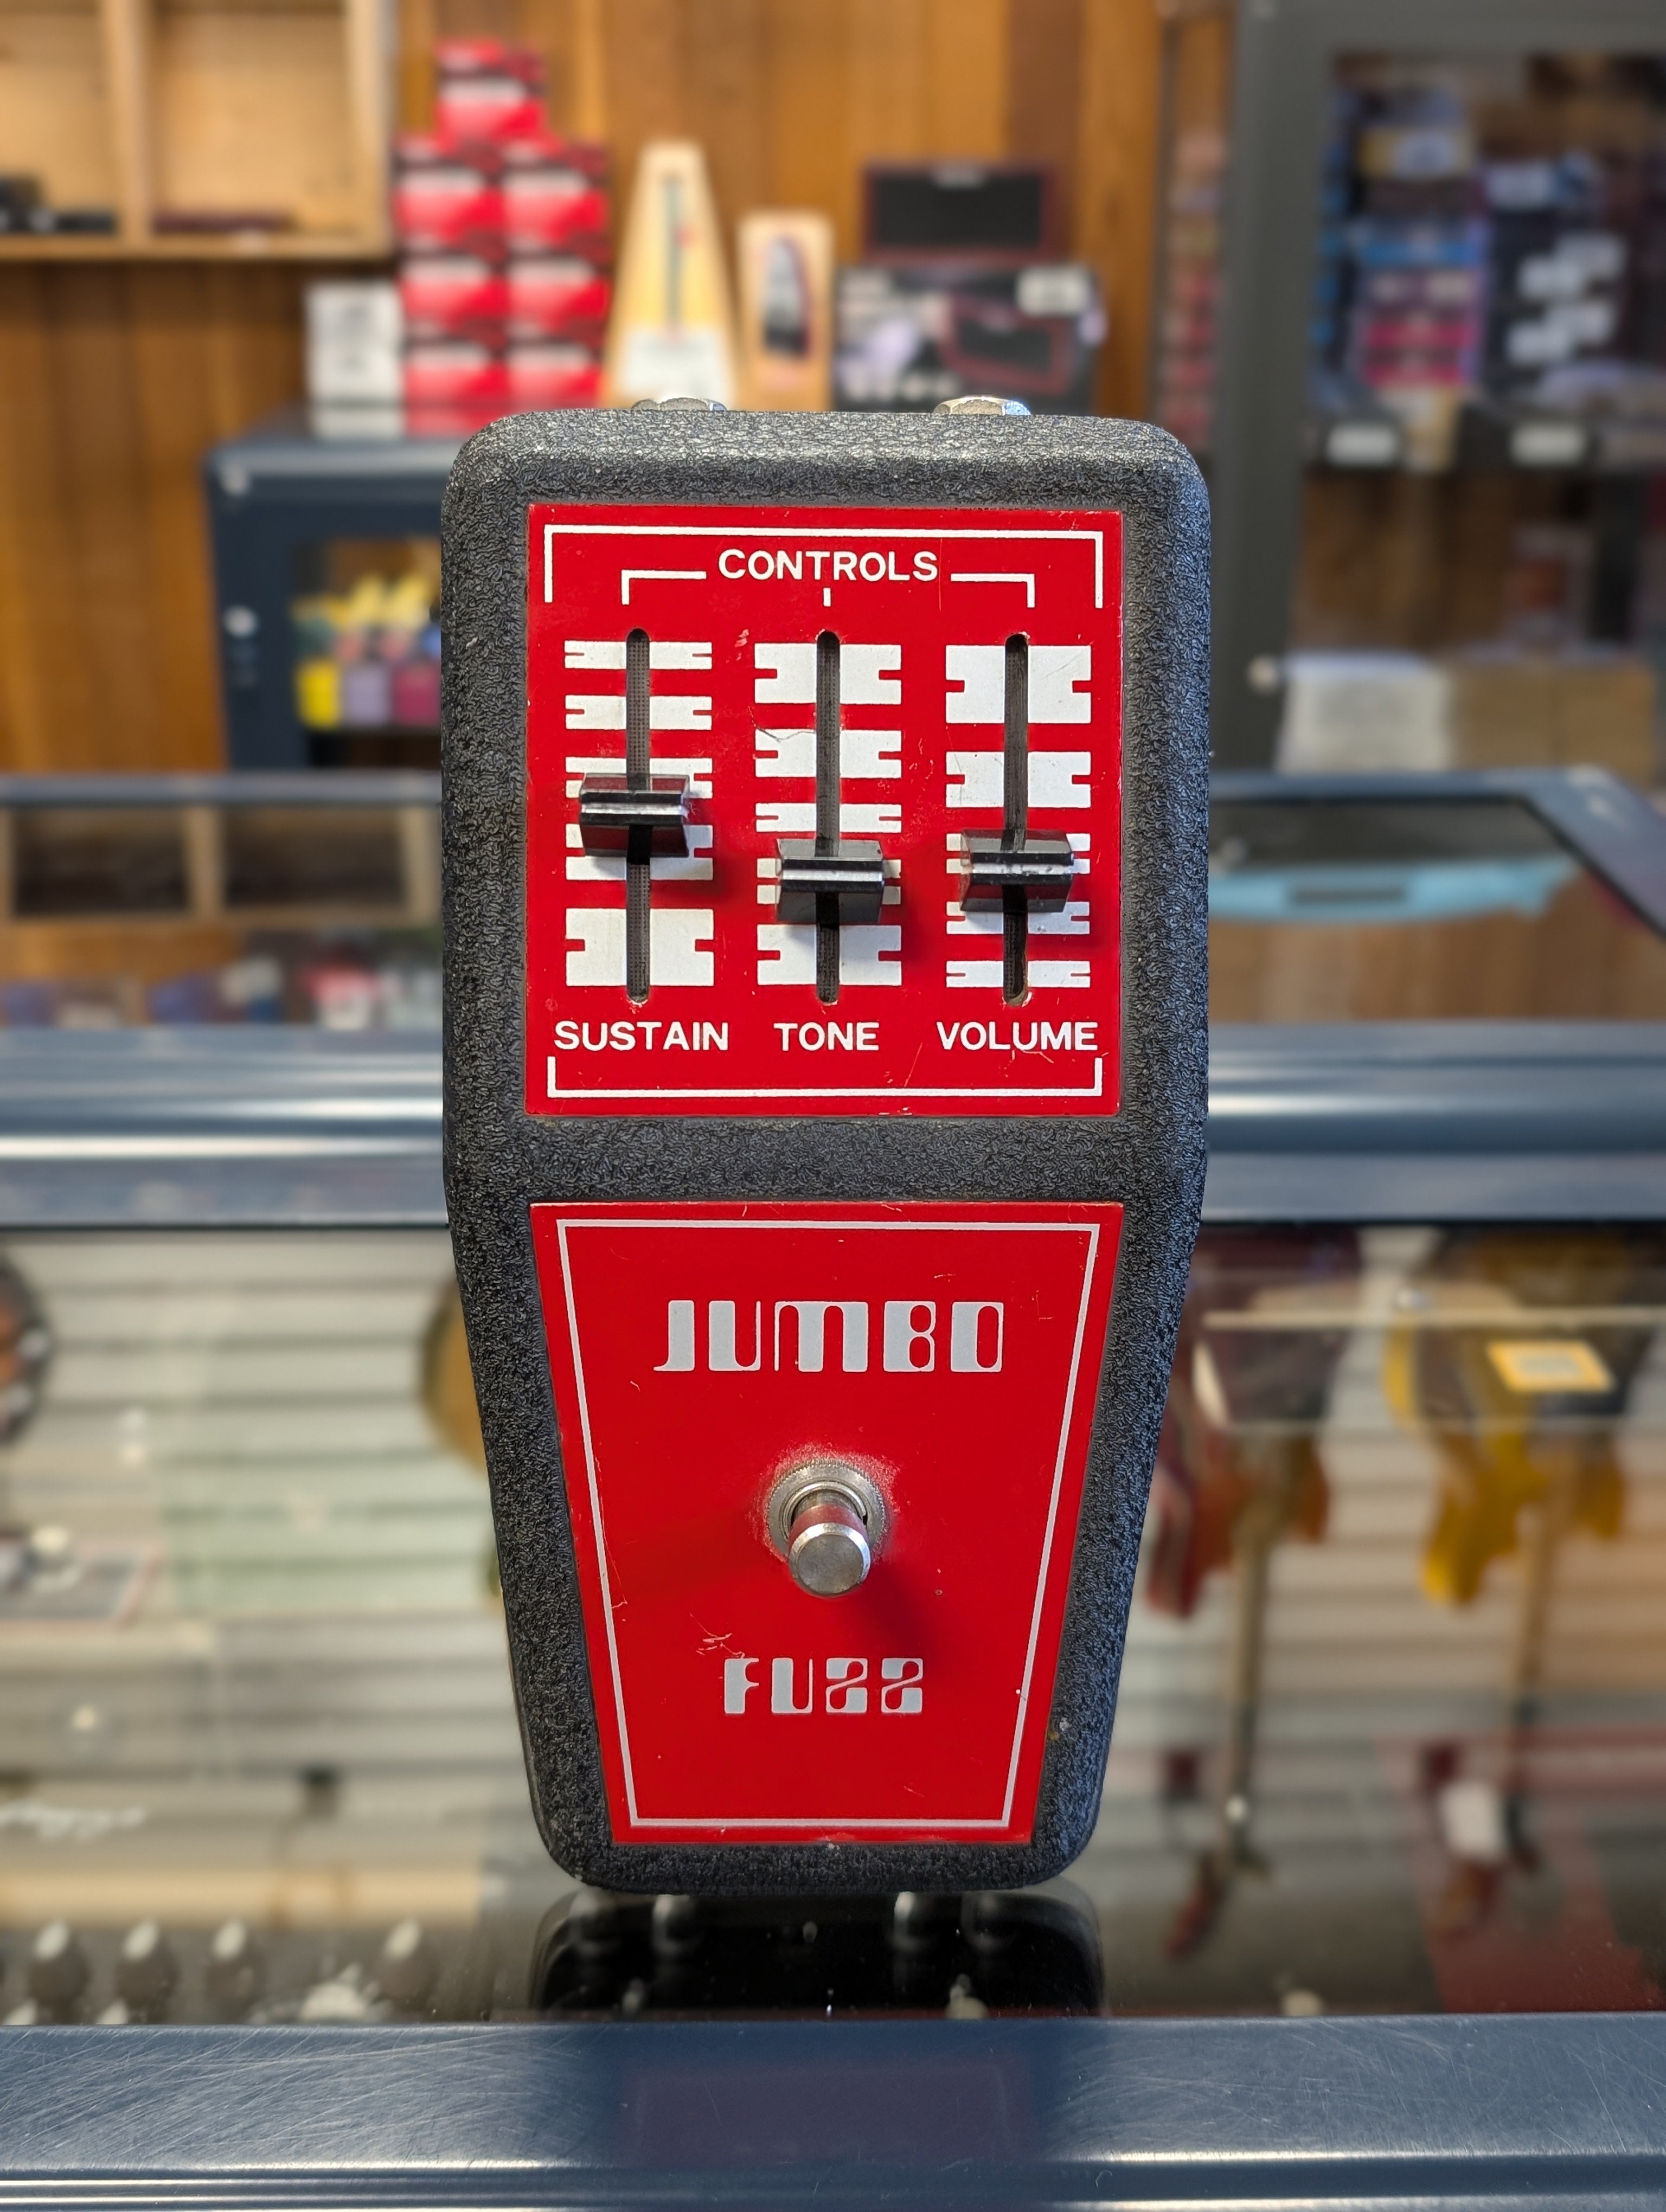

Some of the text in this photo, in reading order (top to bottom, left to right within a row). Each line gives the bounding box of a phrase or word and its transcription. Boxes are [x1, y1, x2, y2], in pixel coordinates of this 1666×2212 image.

[717, 549, 938, 582] CONTROLS
[554, 1020, 729, 1051] SUSTAIN
[773, 1021, 880, 1051] TONE
[935, 1021, 1099, 1051] VOLUME
[653, 1299, 1004, 1373] JUMBO
[723, 1656, 924, 1715] FUZZ
